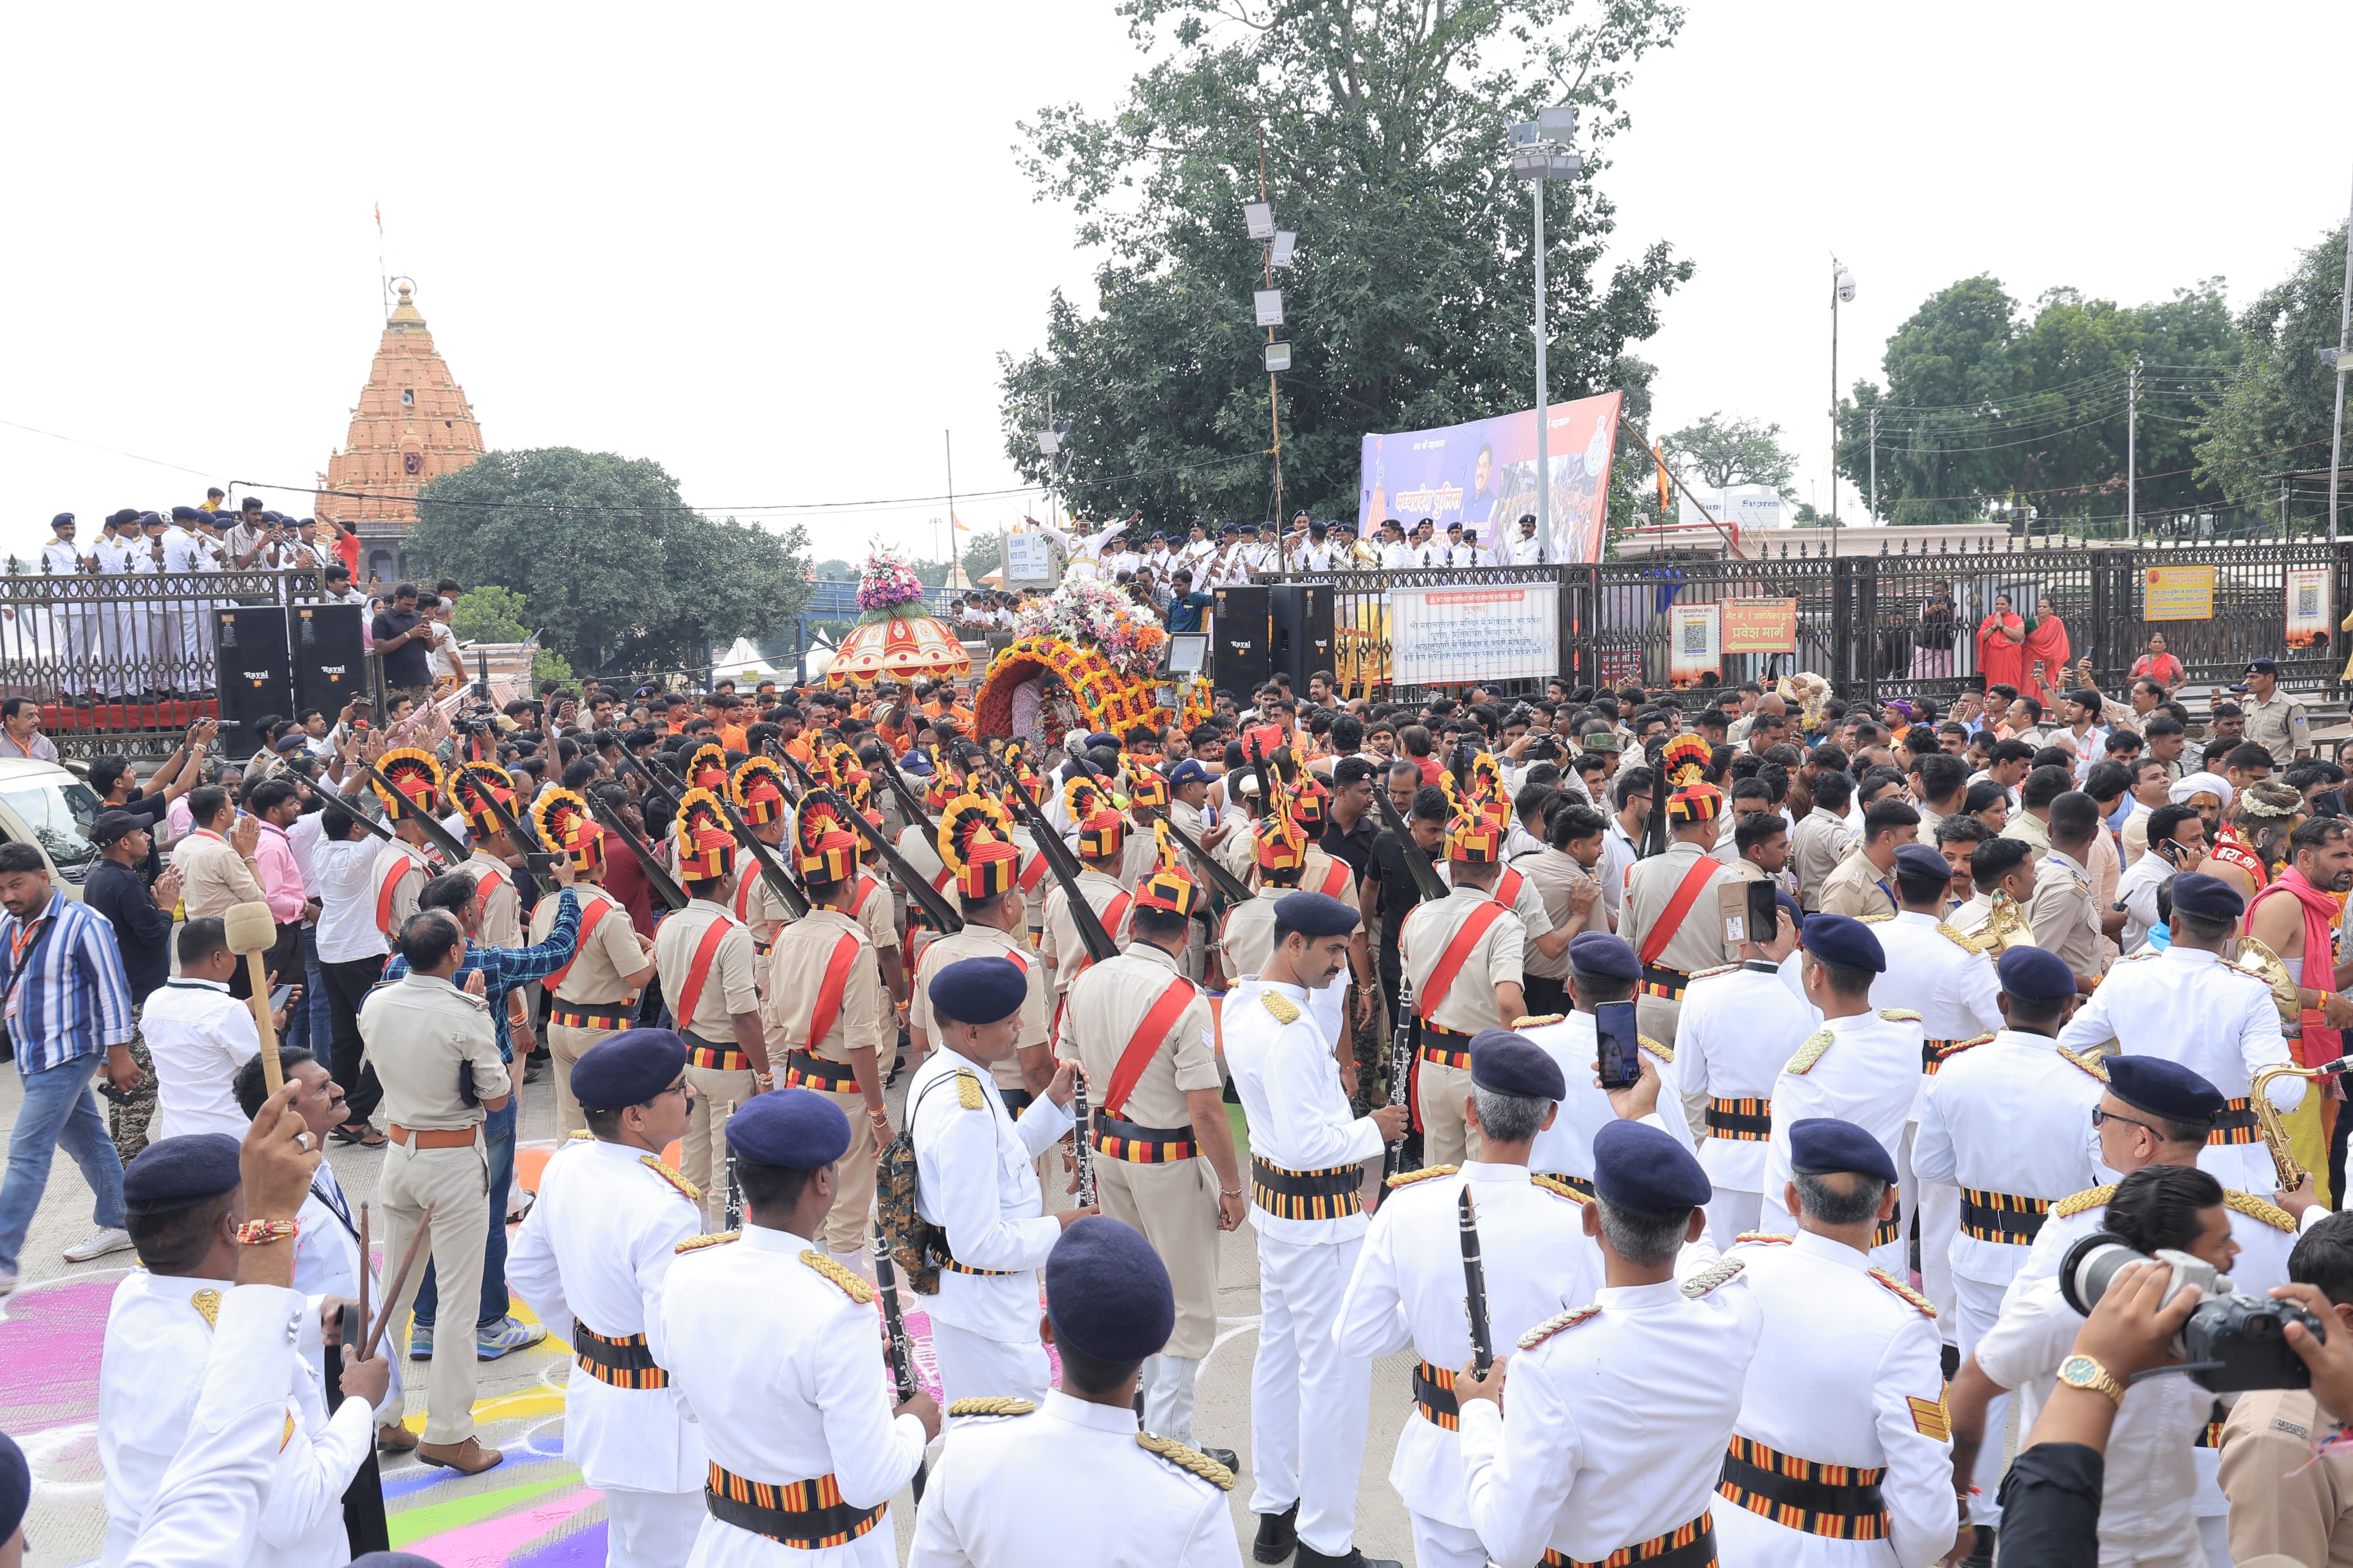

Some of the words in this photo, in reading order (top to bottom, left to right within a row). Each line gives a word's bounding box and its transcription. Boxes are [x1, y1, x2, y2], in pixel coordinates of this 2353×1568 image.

[1397, 483, 1433, 513] मध्यप्रदेश
[1432, 482, 1463, 519] पुलिस
[1463, 606, 1486, 615] सूचना
[1725, 610, 1736, 619] गेट
[1753, 610, 1780, 620] अवंतिका
[1527, 615, 1542, 624] प्रवेश
[1732, 623, 1760, 639] प्रवेश
[1762, 623, 1786, 638] मार्ग
[1459, 639, 1481, 647] निवेदन
[1490, 638, 1505, 646] अपने
[1516, 648, 1530, 656] प्रवेश
[321, 665, 345, 673] Rayal
[244, 670, 269, 679] Rayal
